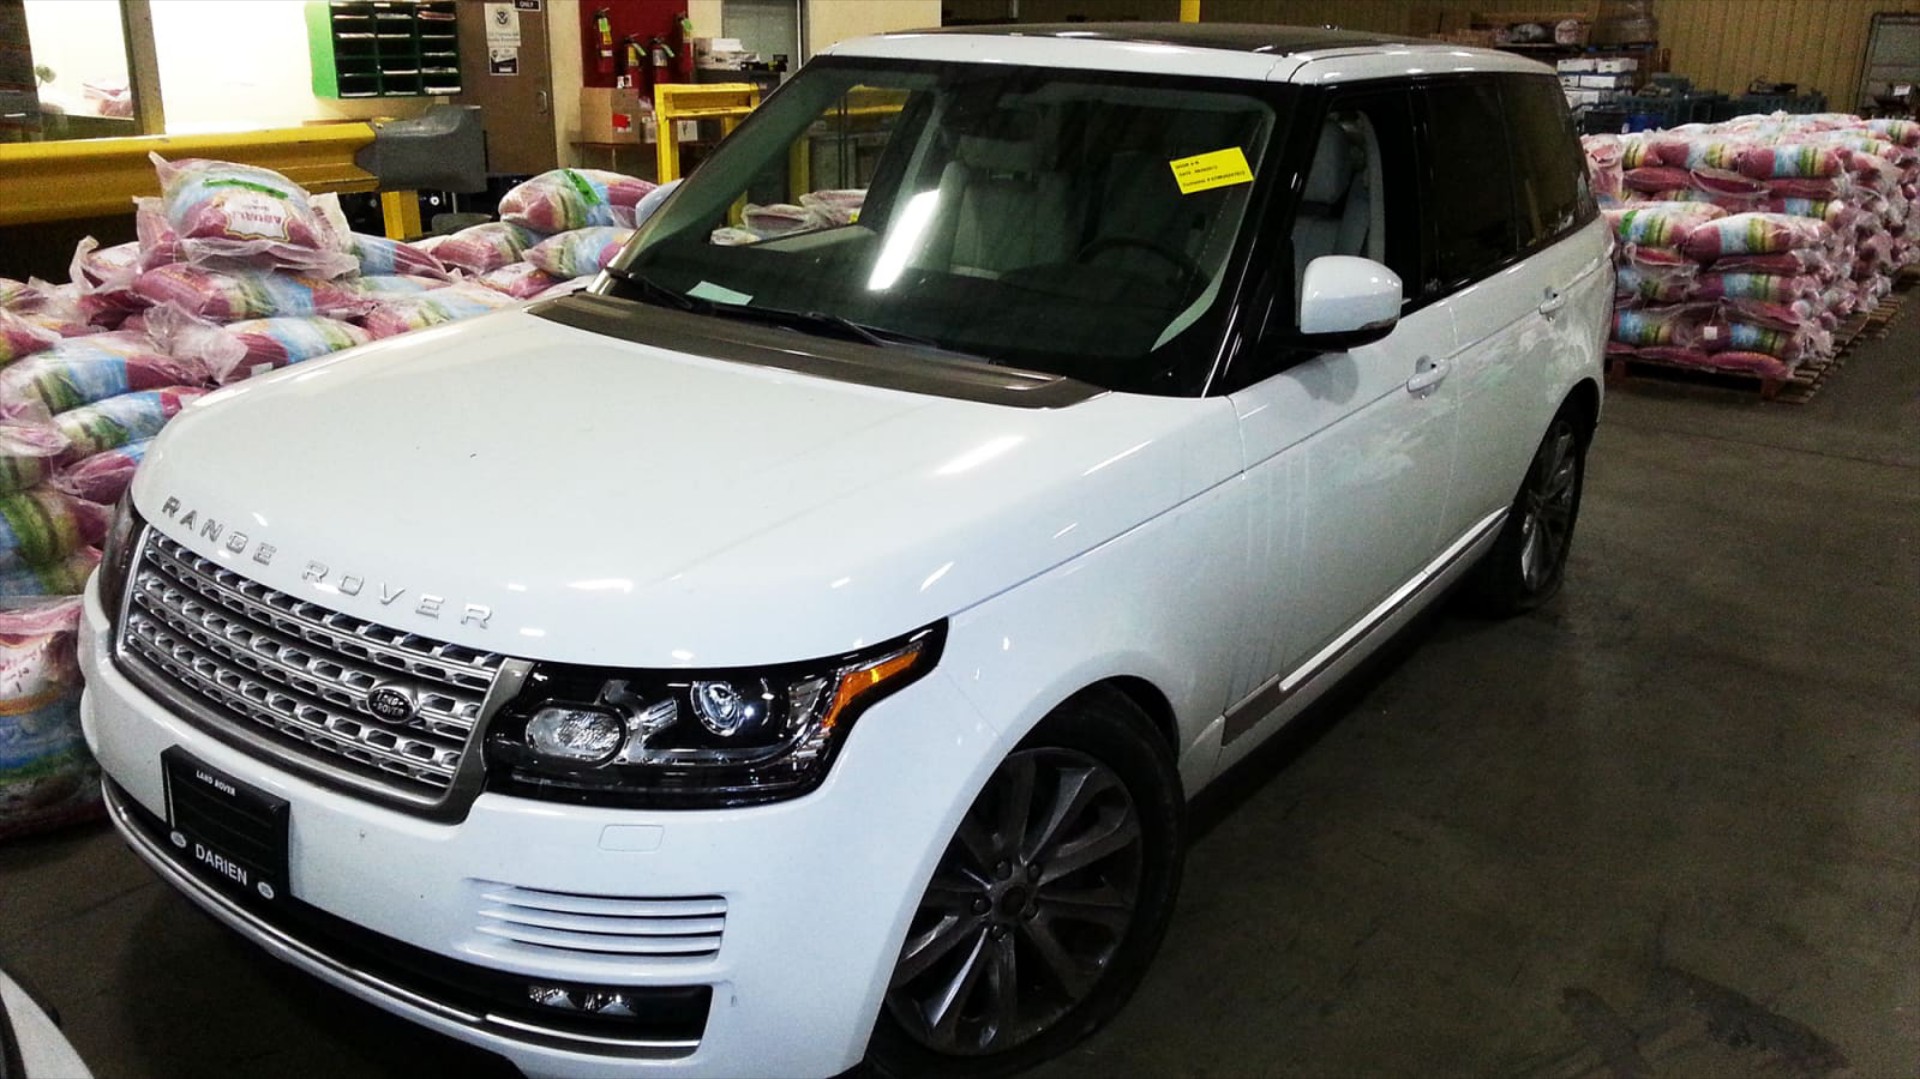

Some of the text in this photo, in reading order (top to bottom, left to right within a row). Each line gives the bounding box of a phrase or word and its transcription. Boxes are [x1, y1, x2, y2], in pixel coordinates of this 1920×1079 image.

[161, 496, 492, 628] RANGE ROVER
[196, 770, 236, 797] LAND ROVER
[195, 843, 248, 887] DARIEN
